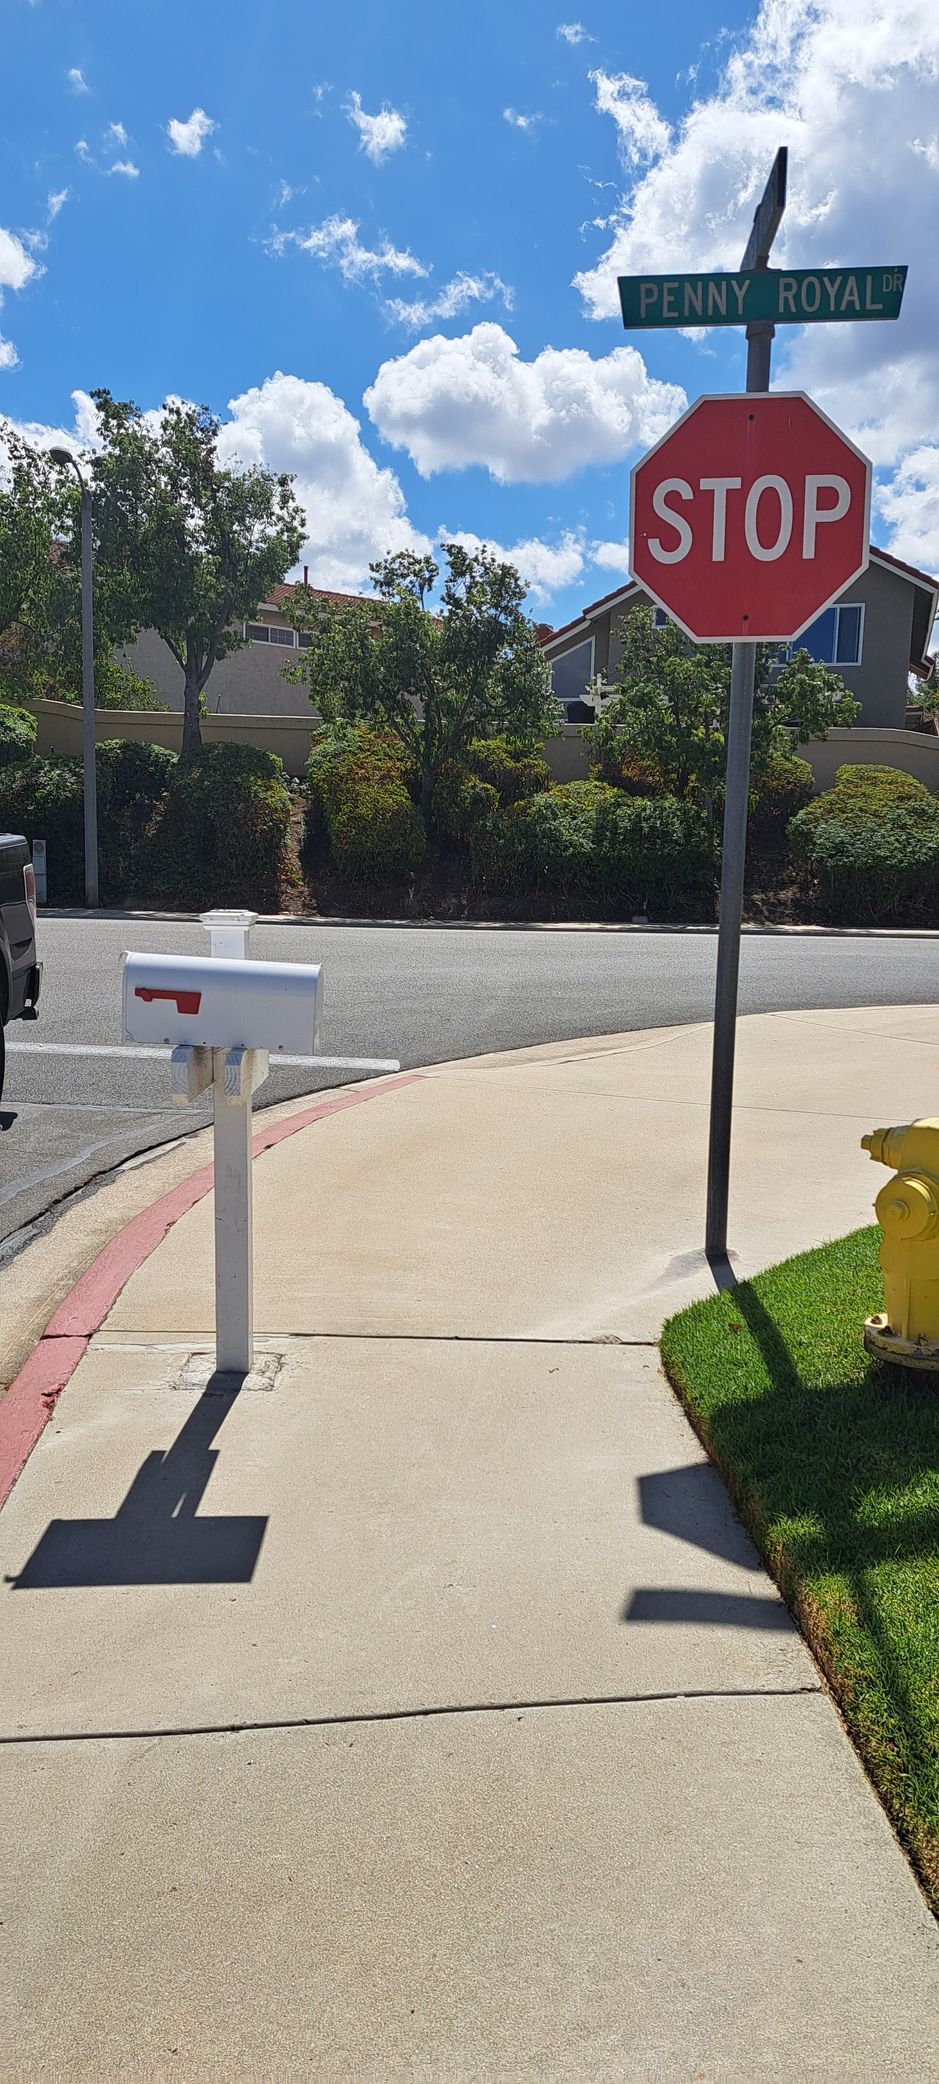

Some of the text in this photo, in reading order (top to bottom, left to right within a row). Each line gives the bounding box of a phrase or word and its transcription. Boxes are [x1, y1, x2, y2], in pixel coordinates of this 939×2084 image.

[640, 273, 903, 319] PENNY ROYAL DR
[648, 474, 851, 564] STOP
